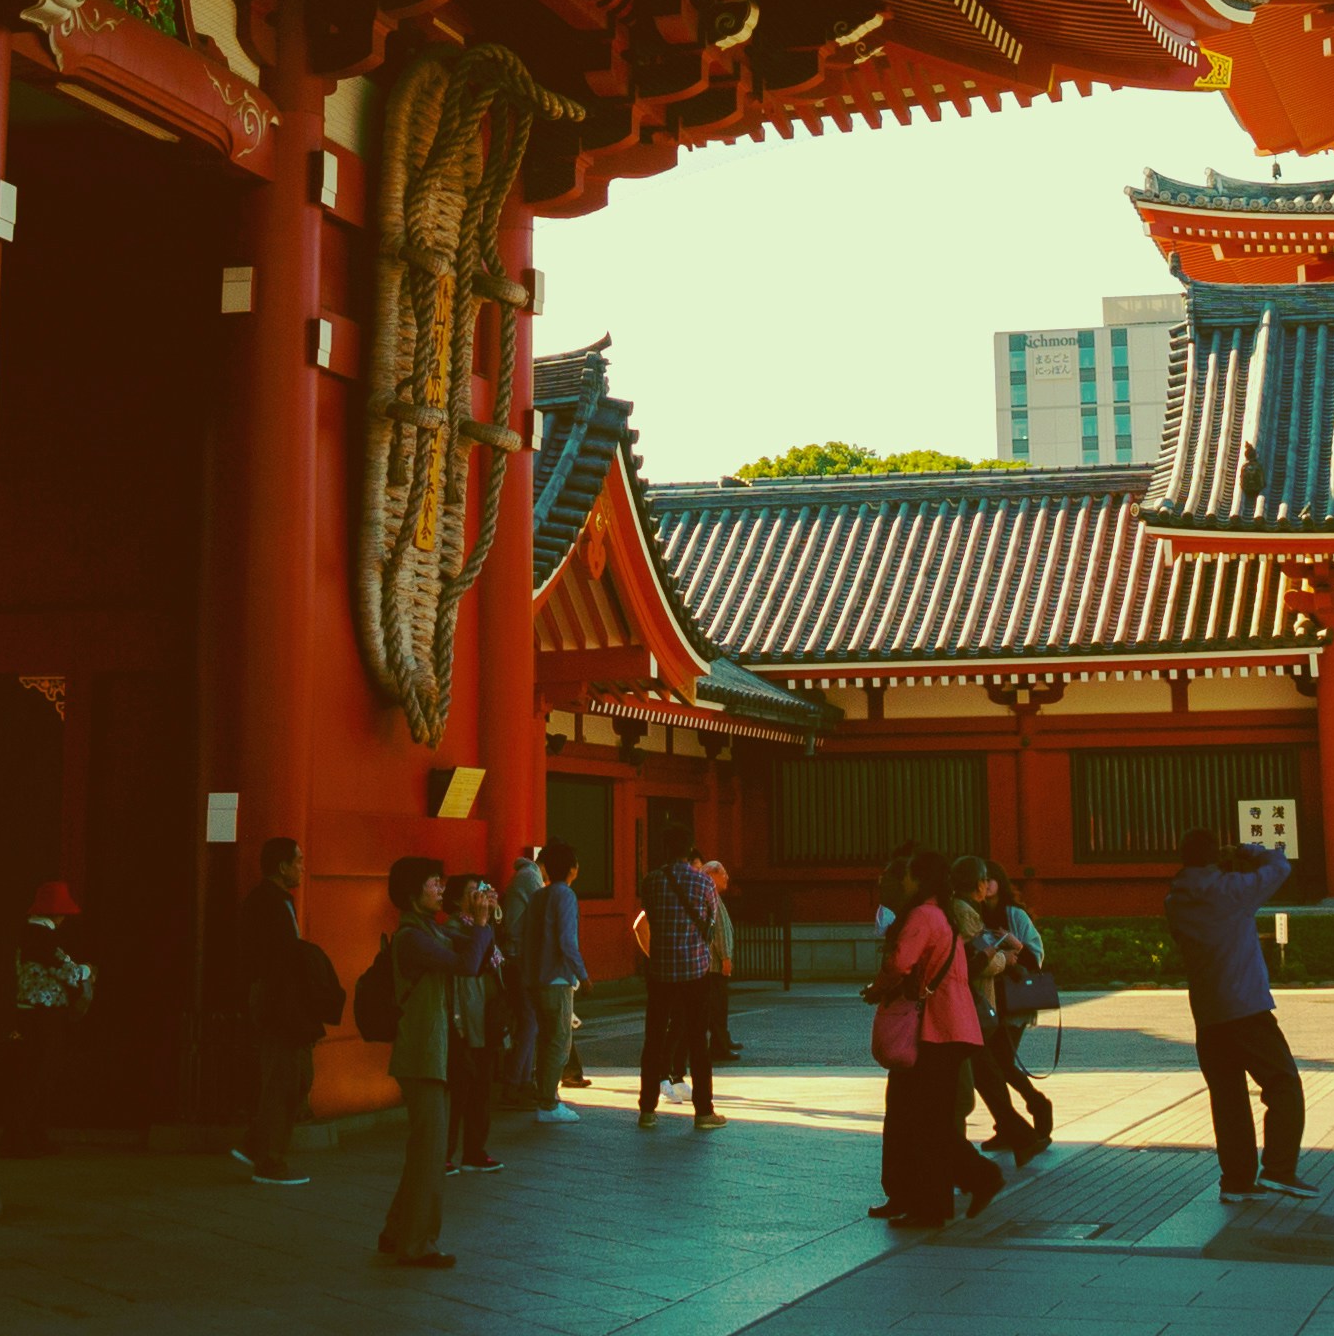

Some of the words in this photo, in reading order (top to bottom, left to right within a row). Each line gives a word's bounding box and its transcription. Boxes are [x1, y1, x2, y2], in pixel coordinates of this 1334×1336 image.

[1035, 353, 1069, 364] まるごと
[1035, 365, 1070, 375] にっぽん
[1250, 806, 1263, 845] 寺務
